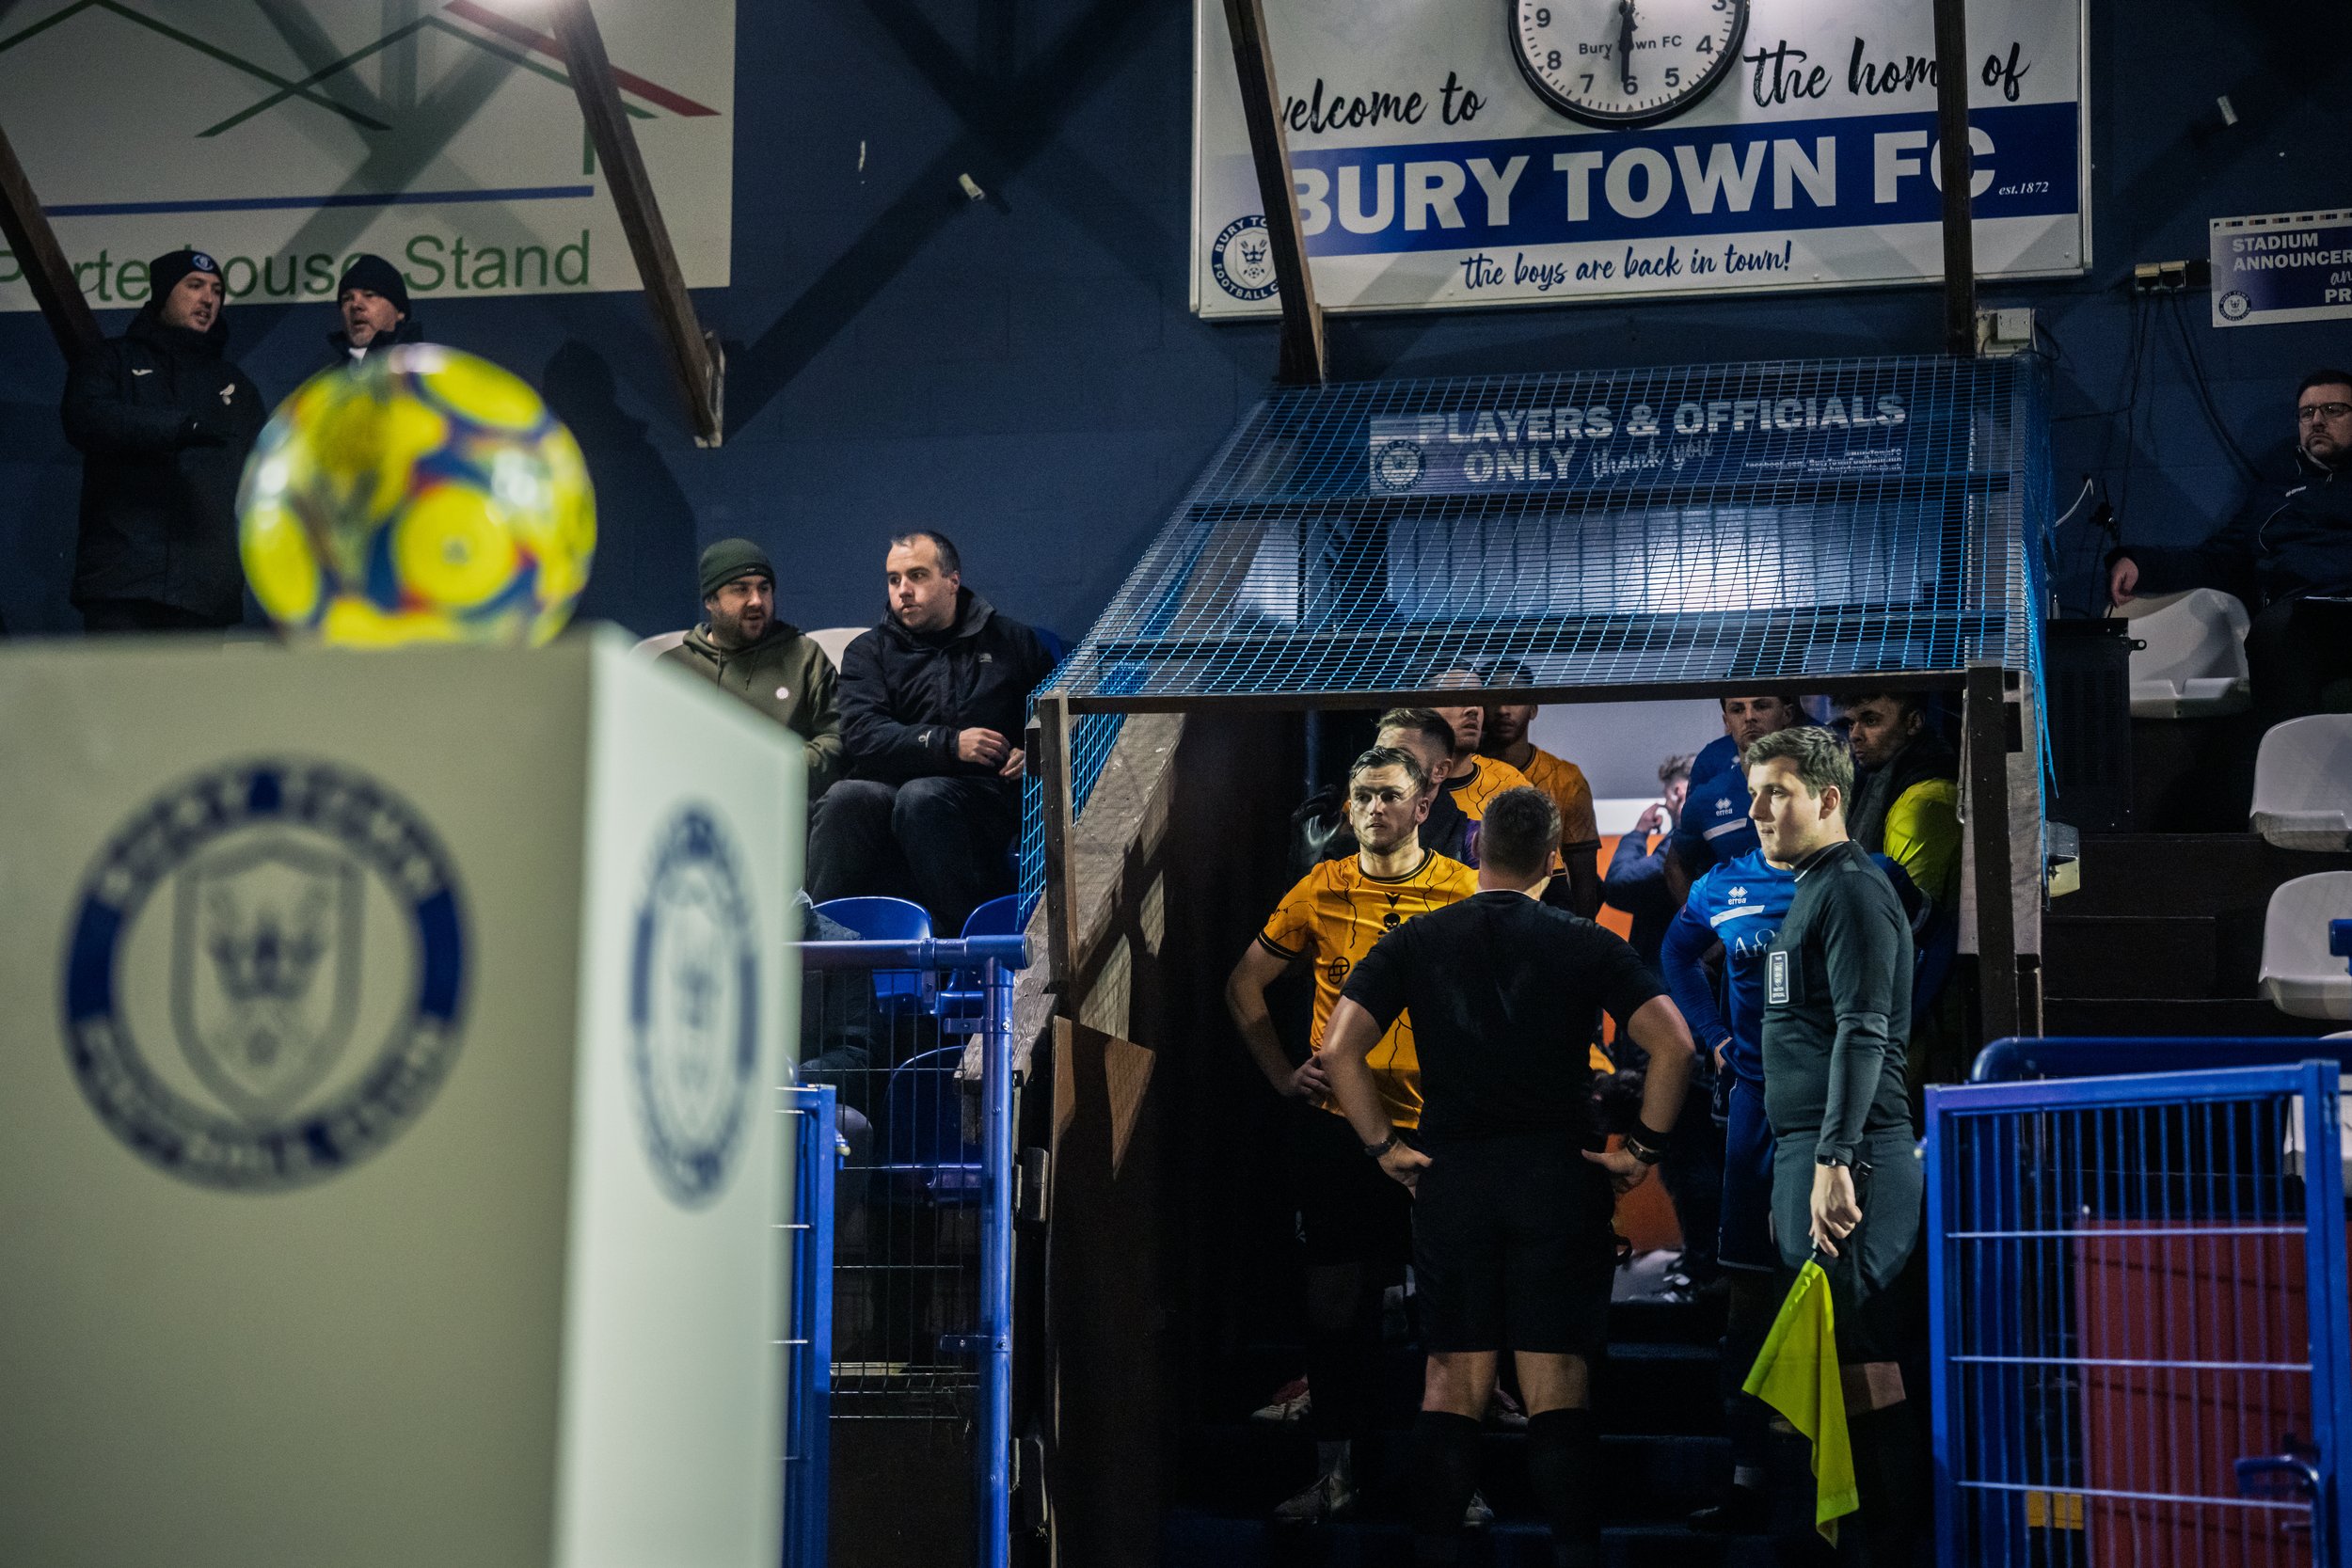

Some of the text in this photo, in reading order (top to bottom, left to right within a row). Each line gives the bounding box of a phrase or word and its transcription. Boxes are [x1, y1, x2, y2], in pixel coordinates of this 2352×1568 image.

[1536, 8, 1551, 28] 9
[1547, 51, 1562, 71] 8
[1579, 43, 1613, 55] Bury
[1662, 36, 1682, 48] FC
[1695, 35, 1713, 55] 4
[1581, 74, 1595, 93] 7
[1624, 76, 1639, 95] 6
[1665, 68, 1680, 87] 5
[1743, 37, 2030, 107] the hom of
[1439, 71, 1486, 125] to
[1293, 126, 1995, 237] BURY TOWN FC
[1215, 219, 1244, 253] BURY
[2233, 232, 2318, 253] STADIUM
[404, 230, 590, 292] Stand
[1460, 240, 1792, 291] the boys are back in town!
[1214, 263, 1267, 299] FOOTBALL
[1418, 394, 1906, 444] PLAYERS & OFFICIALS
[1464, 447, 1577, 483] ONLY
